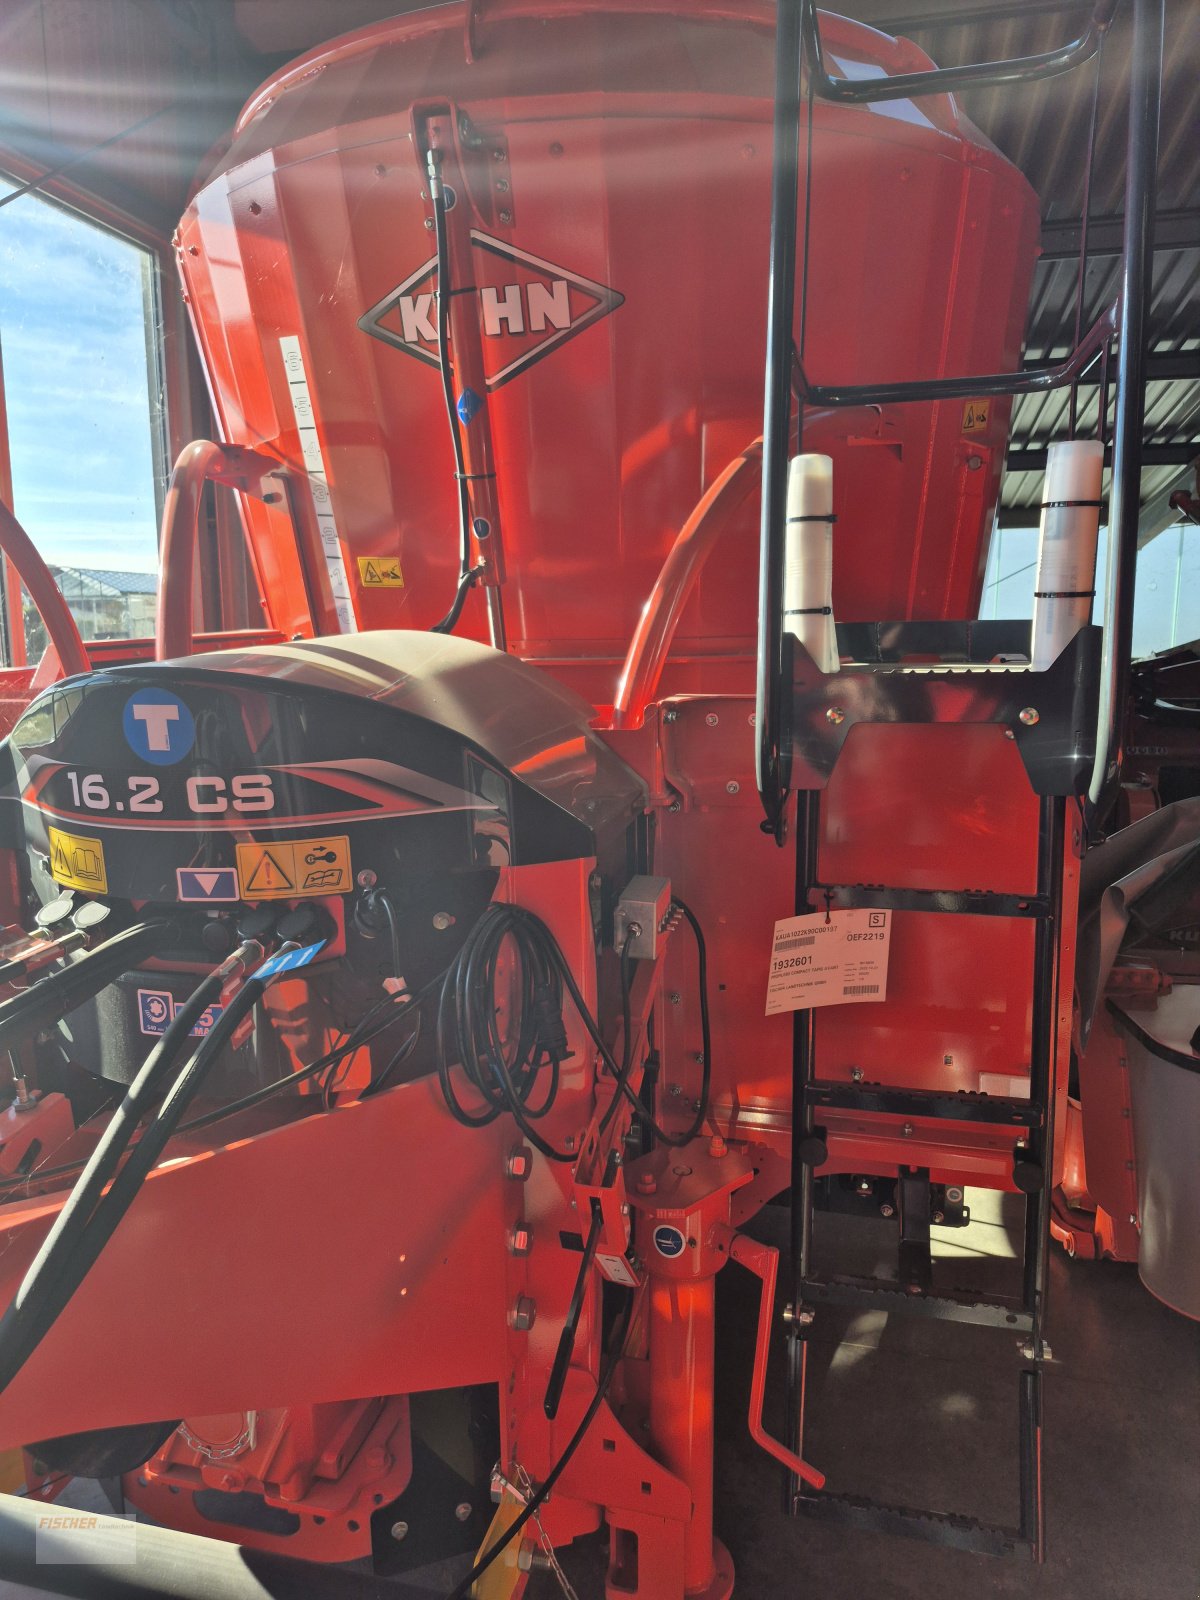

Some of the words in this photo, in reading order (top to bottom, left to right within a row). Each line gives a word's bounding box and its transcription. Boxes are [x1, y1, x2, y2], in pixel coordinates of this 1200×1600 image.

[400, 281, 571, 342] KHN
[132, 704, 179, 751] T
[67, 771, 164, 814] 16.2
[186, 774, 275, 814] CS
[872, 916, 880, 924] S
[773, 956, 813, 971] 1932601
